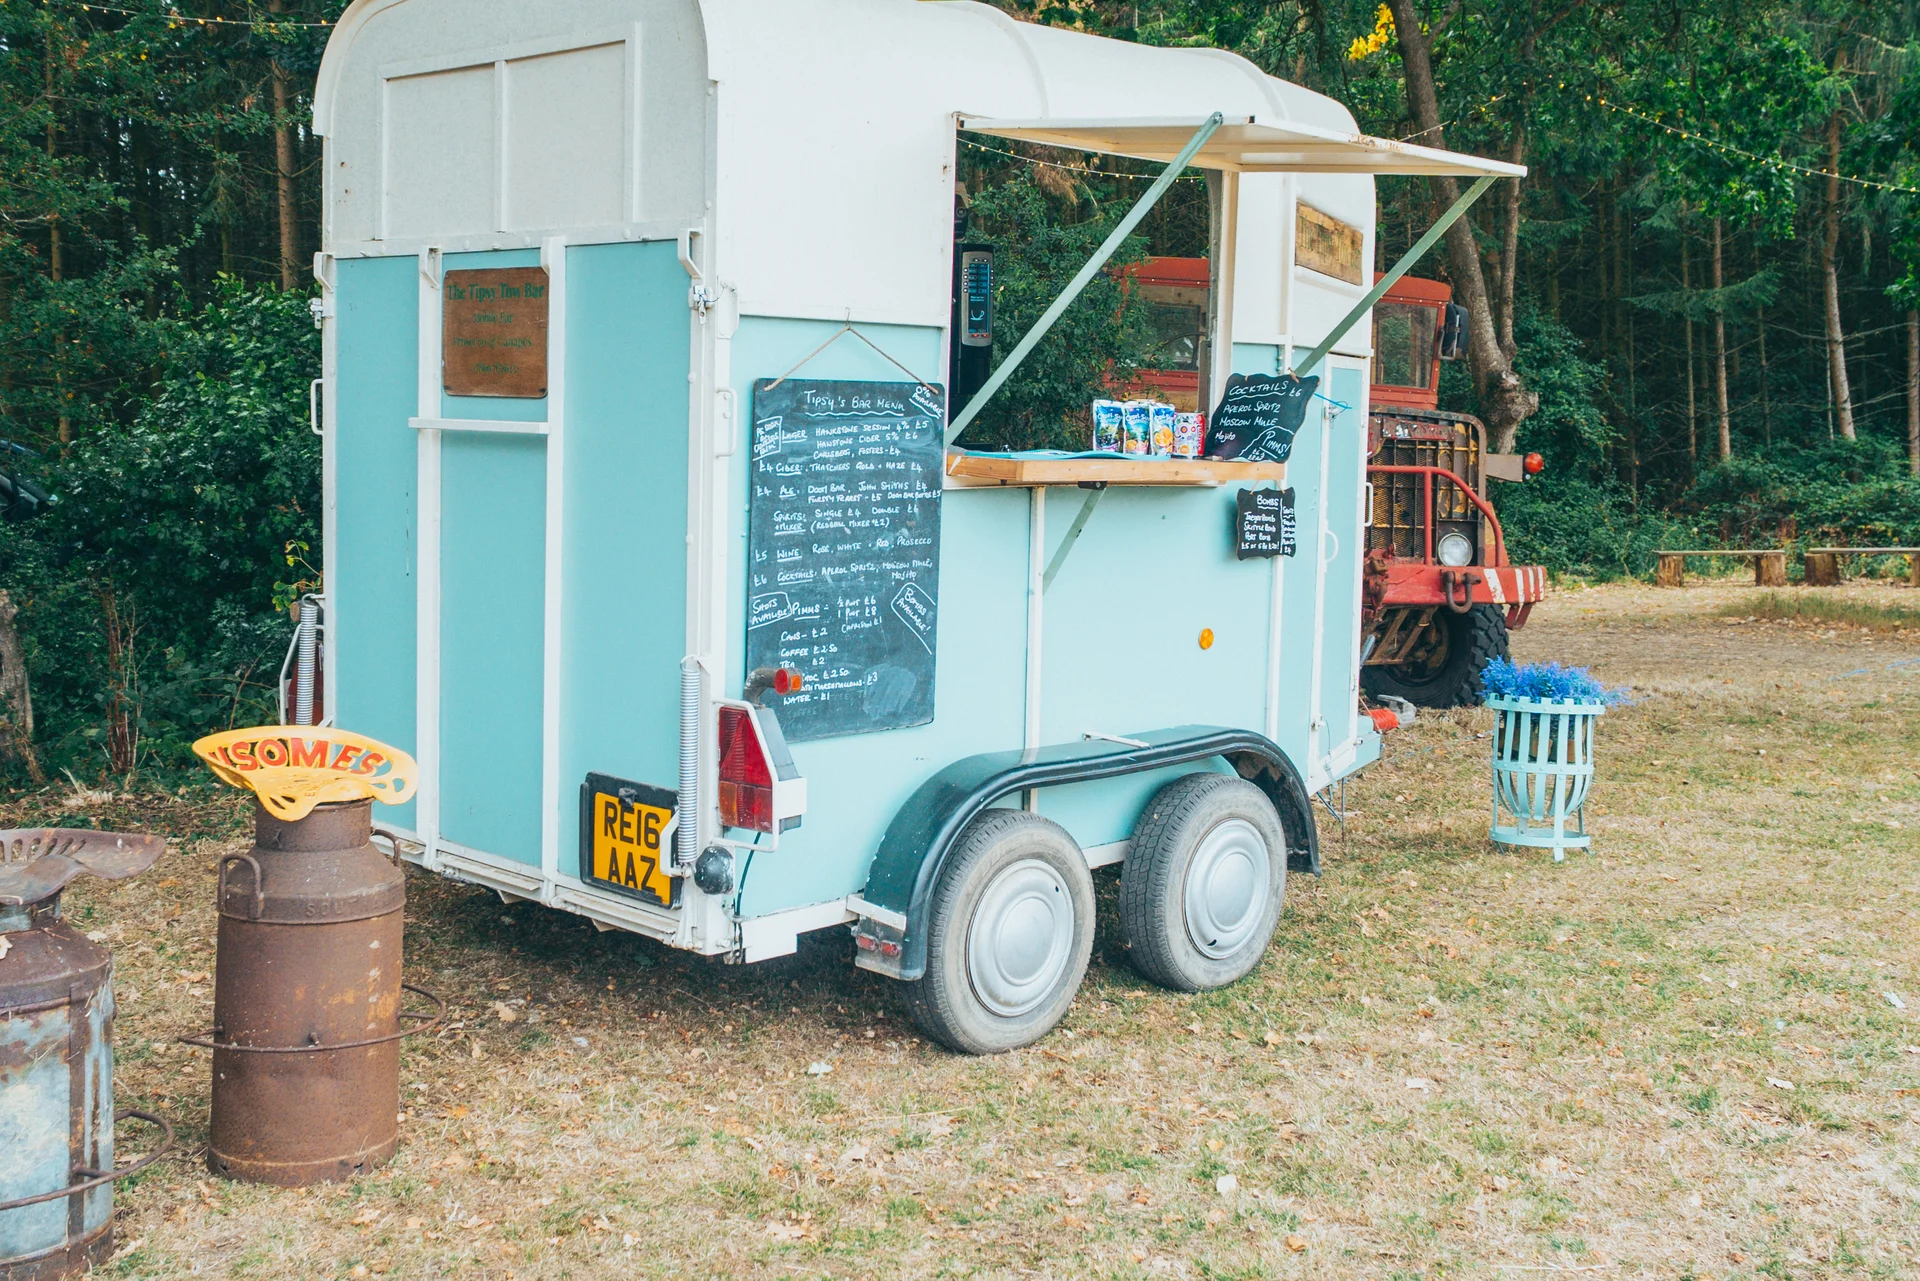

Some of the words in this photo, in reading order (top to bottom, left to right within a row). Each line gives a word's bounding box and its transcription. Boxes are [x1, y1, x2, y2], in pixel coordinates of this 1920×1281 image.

[447, 284, 466, 300] The
[468, 282, 497, 303] Tipsy
[499, 282, 520, 299] Tow
[524, 282, 545, 299] Bar
[1229, 380, 1289, 396] COCKTAILS
[1223, 403, 1252, 414] APEROL
[1254, 400, 1281, 414] SPRITZ
[1219, 415, 1251, 427] MOSCOW
[1253, 415, 1279, 426] MULE
[782, 430, 808, 440] LAGER
[896, 420, 910, 432] 4%
[915, 420, 929, 429] £5
[859, 435, 881, 444] CIDER
[885, 431, 900, 441] 5%
[905, 432, 918, 440] £6
[759, 460, 774, 473] £4
[856, 461, 875, 470] GOLD
[885, 461, 906, 470] HAZE
[911, 461, 923, 473] £4
[756, 485, 772, 497] £4
[807, 485, 828, 494] DOOM
[858, 481, 877, 491] JOHN
[916, 480, 927, 492] £4
[871, 493, 882, 502] £5
[814, 508, 843, 518] SINGLE
[847, 508, 862, 518] £4
[871, 507, 900, 515] DOUBLE
[907, 503, 919, 513] £6
[849, 519, 870, 527] MIXER
[755, 549, 768, 562] £5
[776, 548, 800, 558] WINE
[837, 543, 862, 551] WHITE
[896, 535, 932, 546] PROSECCO
[754, 574, 768, 587] £6
[821, 567, 848, 576] APEROL
[864, 595, 876, 605] £6
[865, 606, 877, 616] £8
[811, 627, 828, 638] £2
[780, 648, 809, 657] COFFEE
[812, 657, 825, 666] £2
[866, 671, 878, 686] £3
[783, 694, 812, 706] WATER
[604, 800, 661, 850] RE16
[607, 847, 656, 894] AAZ
